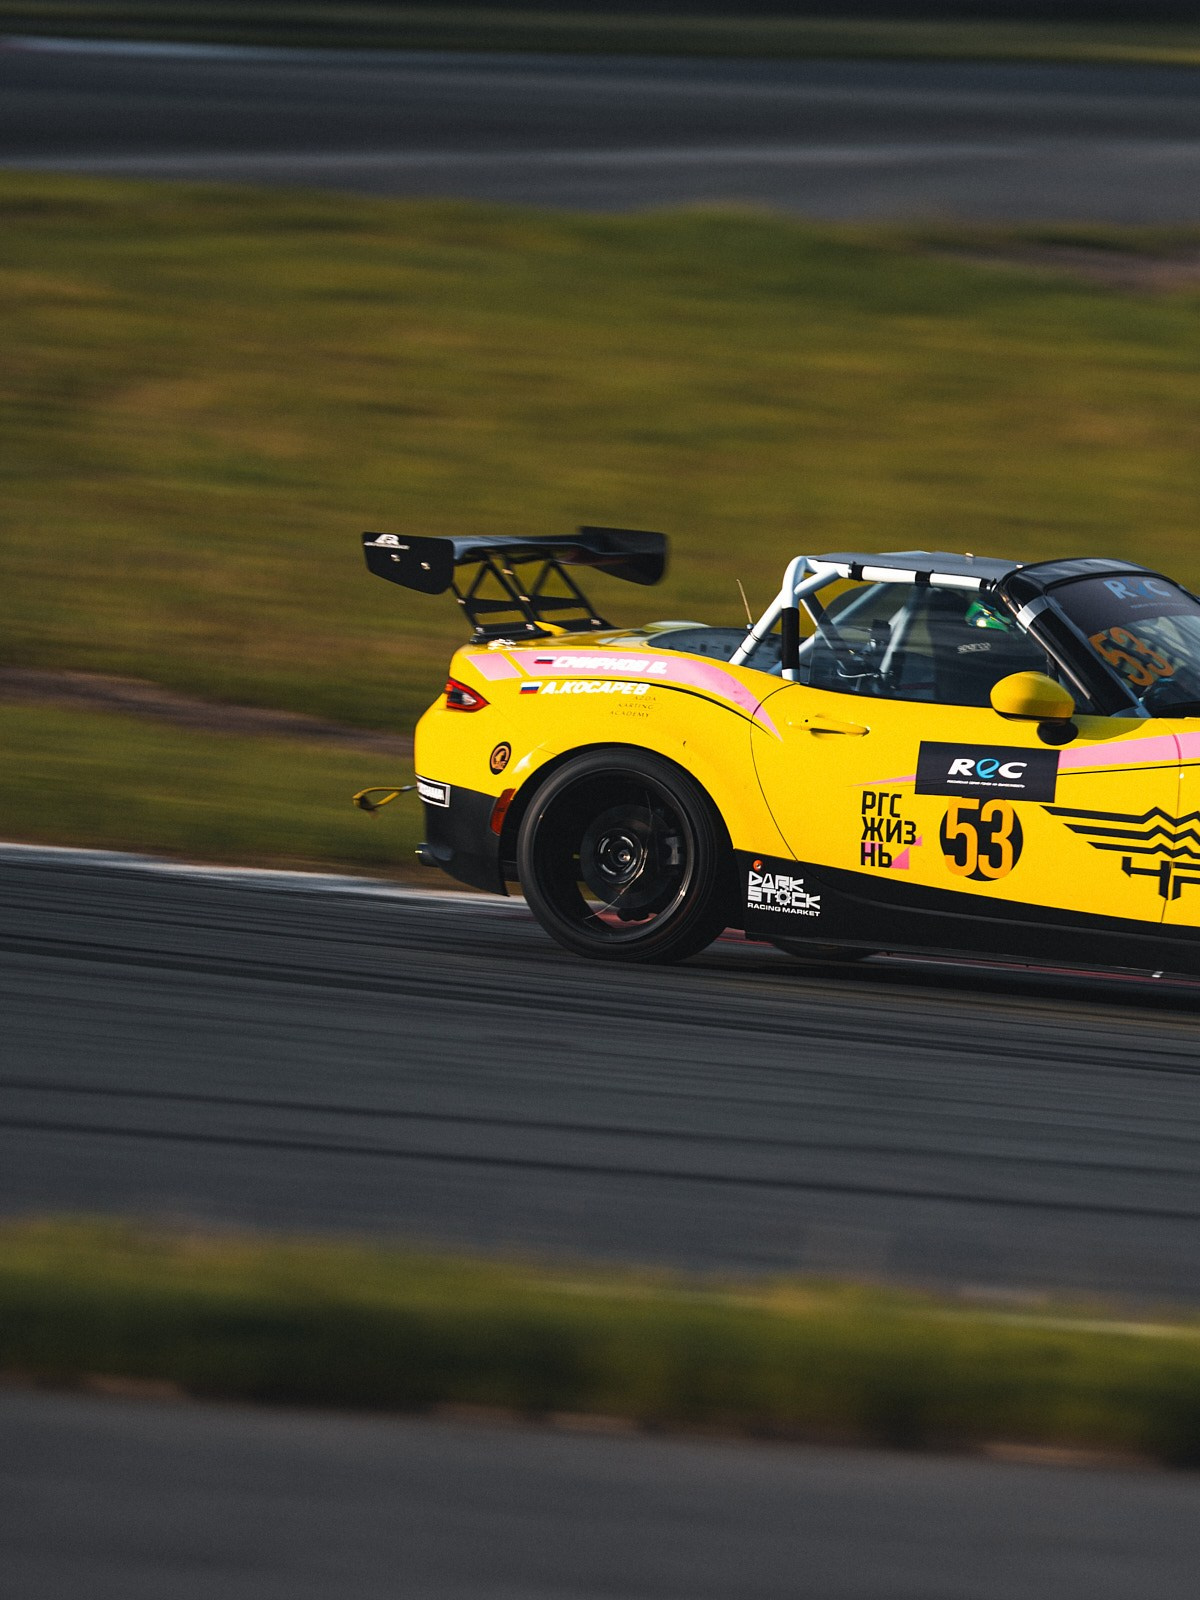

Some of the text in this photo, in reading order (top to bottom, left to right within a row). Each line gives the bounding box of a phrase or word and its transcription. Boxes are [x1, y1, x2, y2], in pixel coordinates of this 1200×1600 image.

[1087, 626, 1175, 686] 53
[861, 790, 902, 819] РГС
[944, 797, 1014, 879] 53
[748, 870, 804, 893] DARK
[747, 886, 821, 911] STOCK
[747, 902, 821, 917] RACING MARKET
